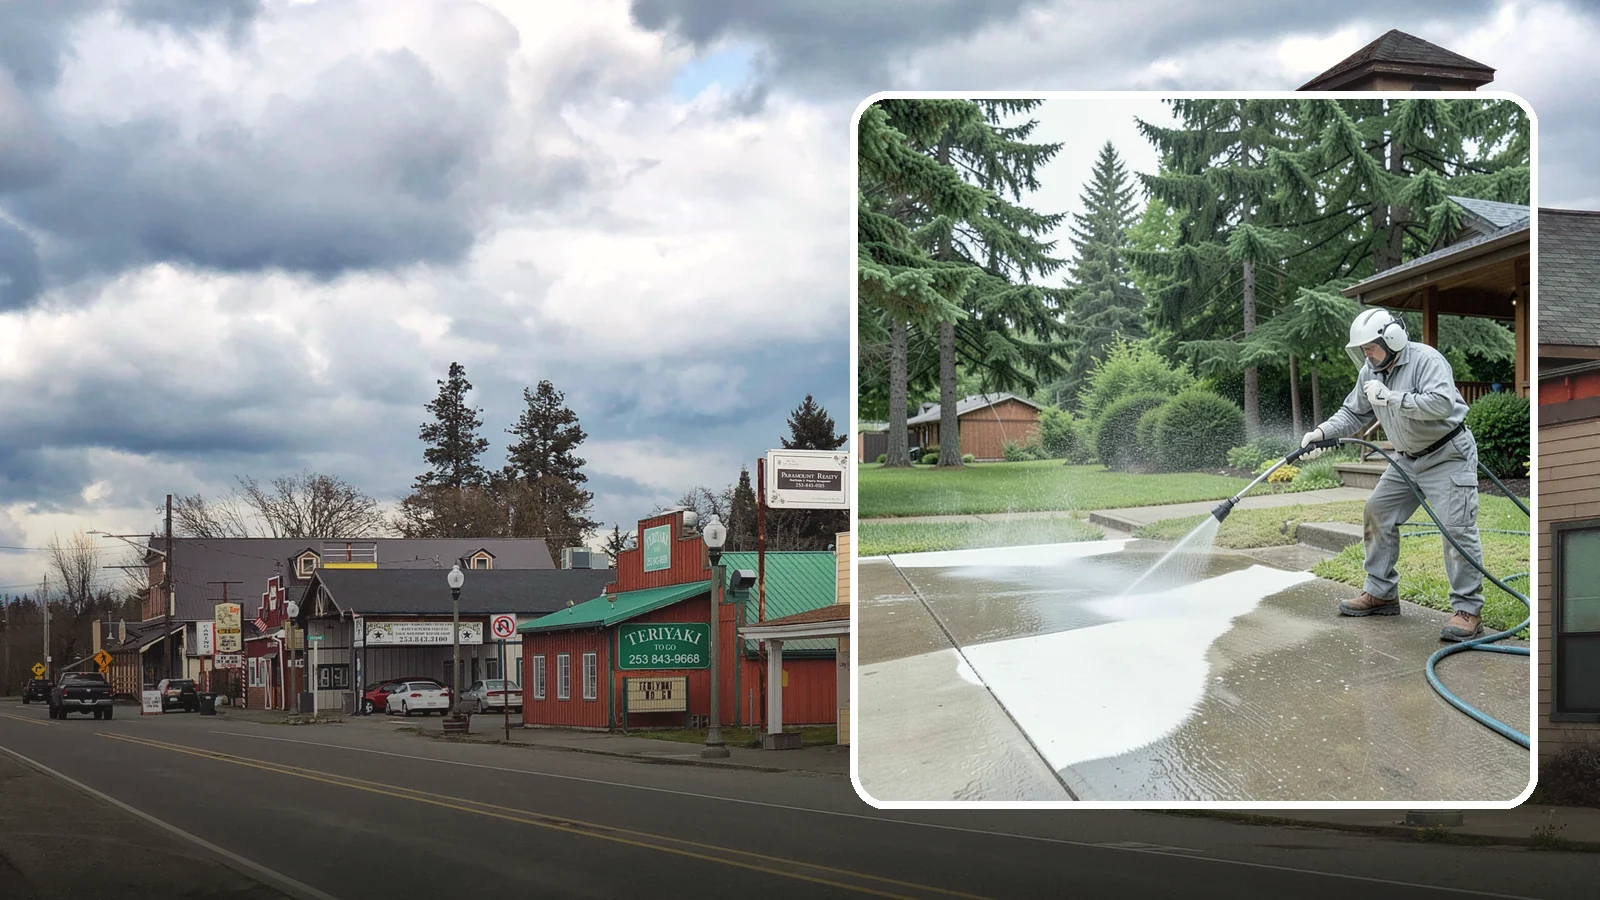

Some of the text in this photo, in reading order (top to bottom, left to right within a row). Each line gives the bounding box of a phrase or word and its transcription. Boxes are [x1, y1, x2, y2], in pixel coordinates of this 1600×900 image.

[625, 627, 703, 646] TERIYAKI
[654, 643, 677, 651] TO GO
[629, 653, 700, 665] 253 843-9668
